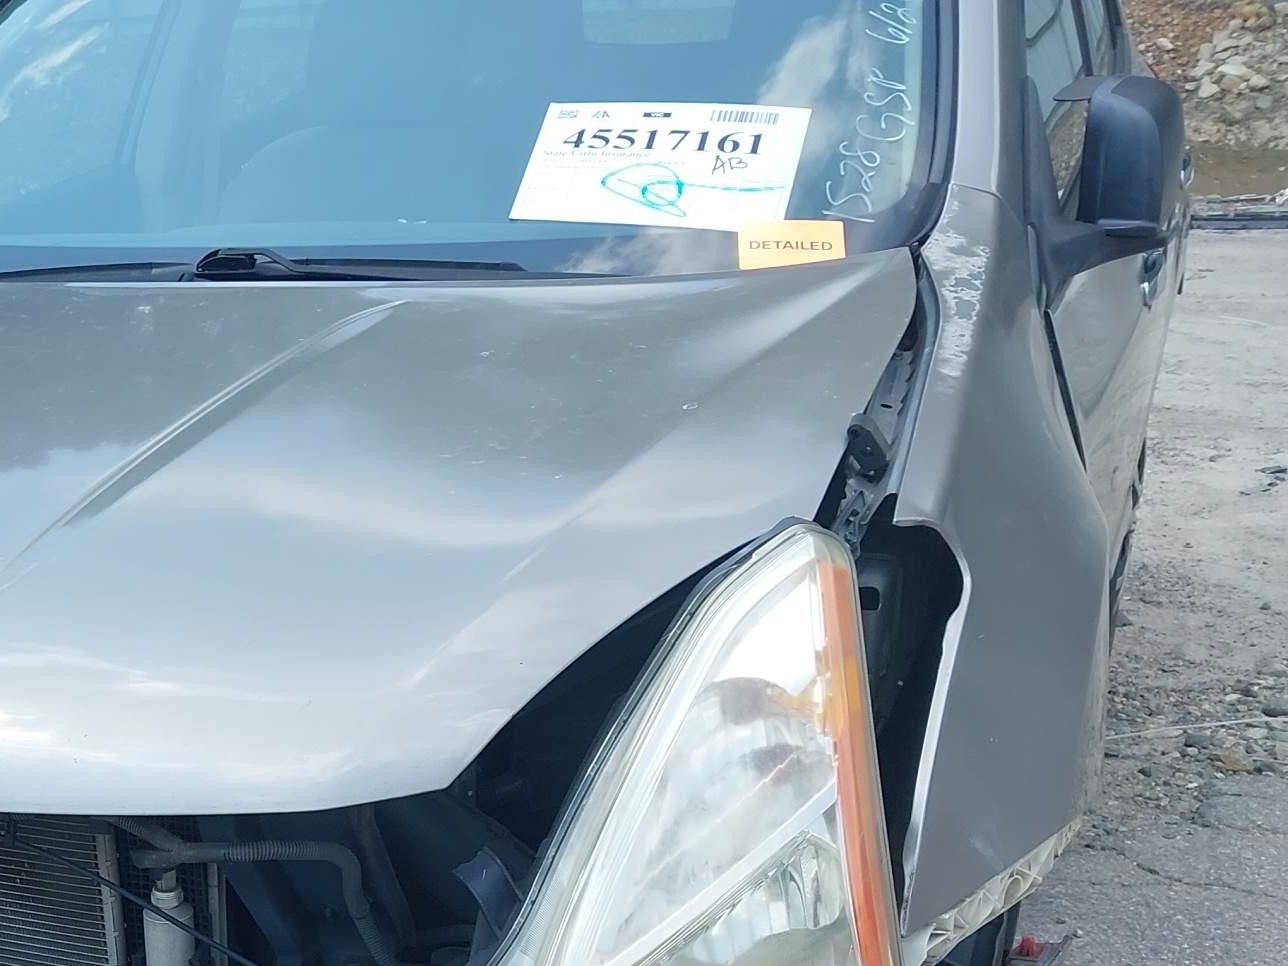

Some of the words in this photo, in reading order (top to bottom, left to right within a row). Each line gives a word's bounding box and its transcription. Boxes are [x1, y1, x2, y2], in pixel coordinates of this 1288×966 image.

[562, 128, 763, 155] 45517161
[711, 154, 749, 175] AB
[748, 240, 833, 251] DETAILED
